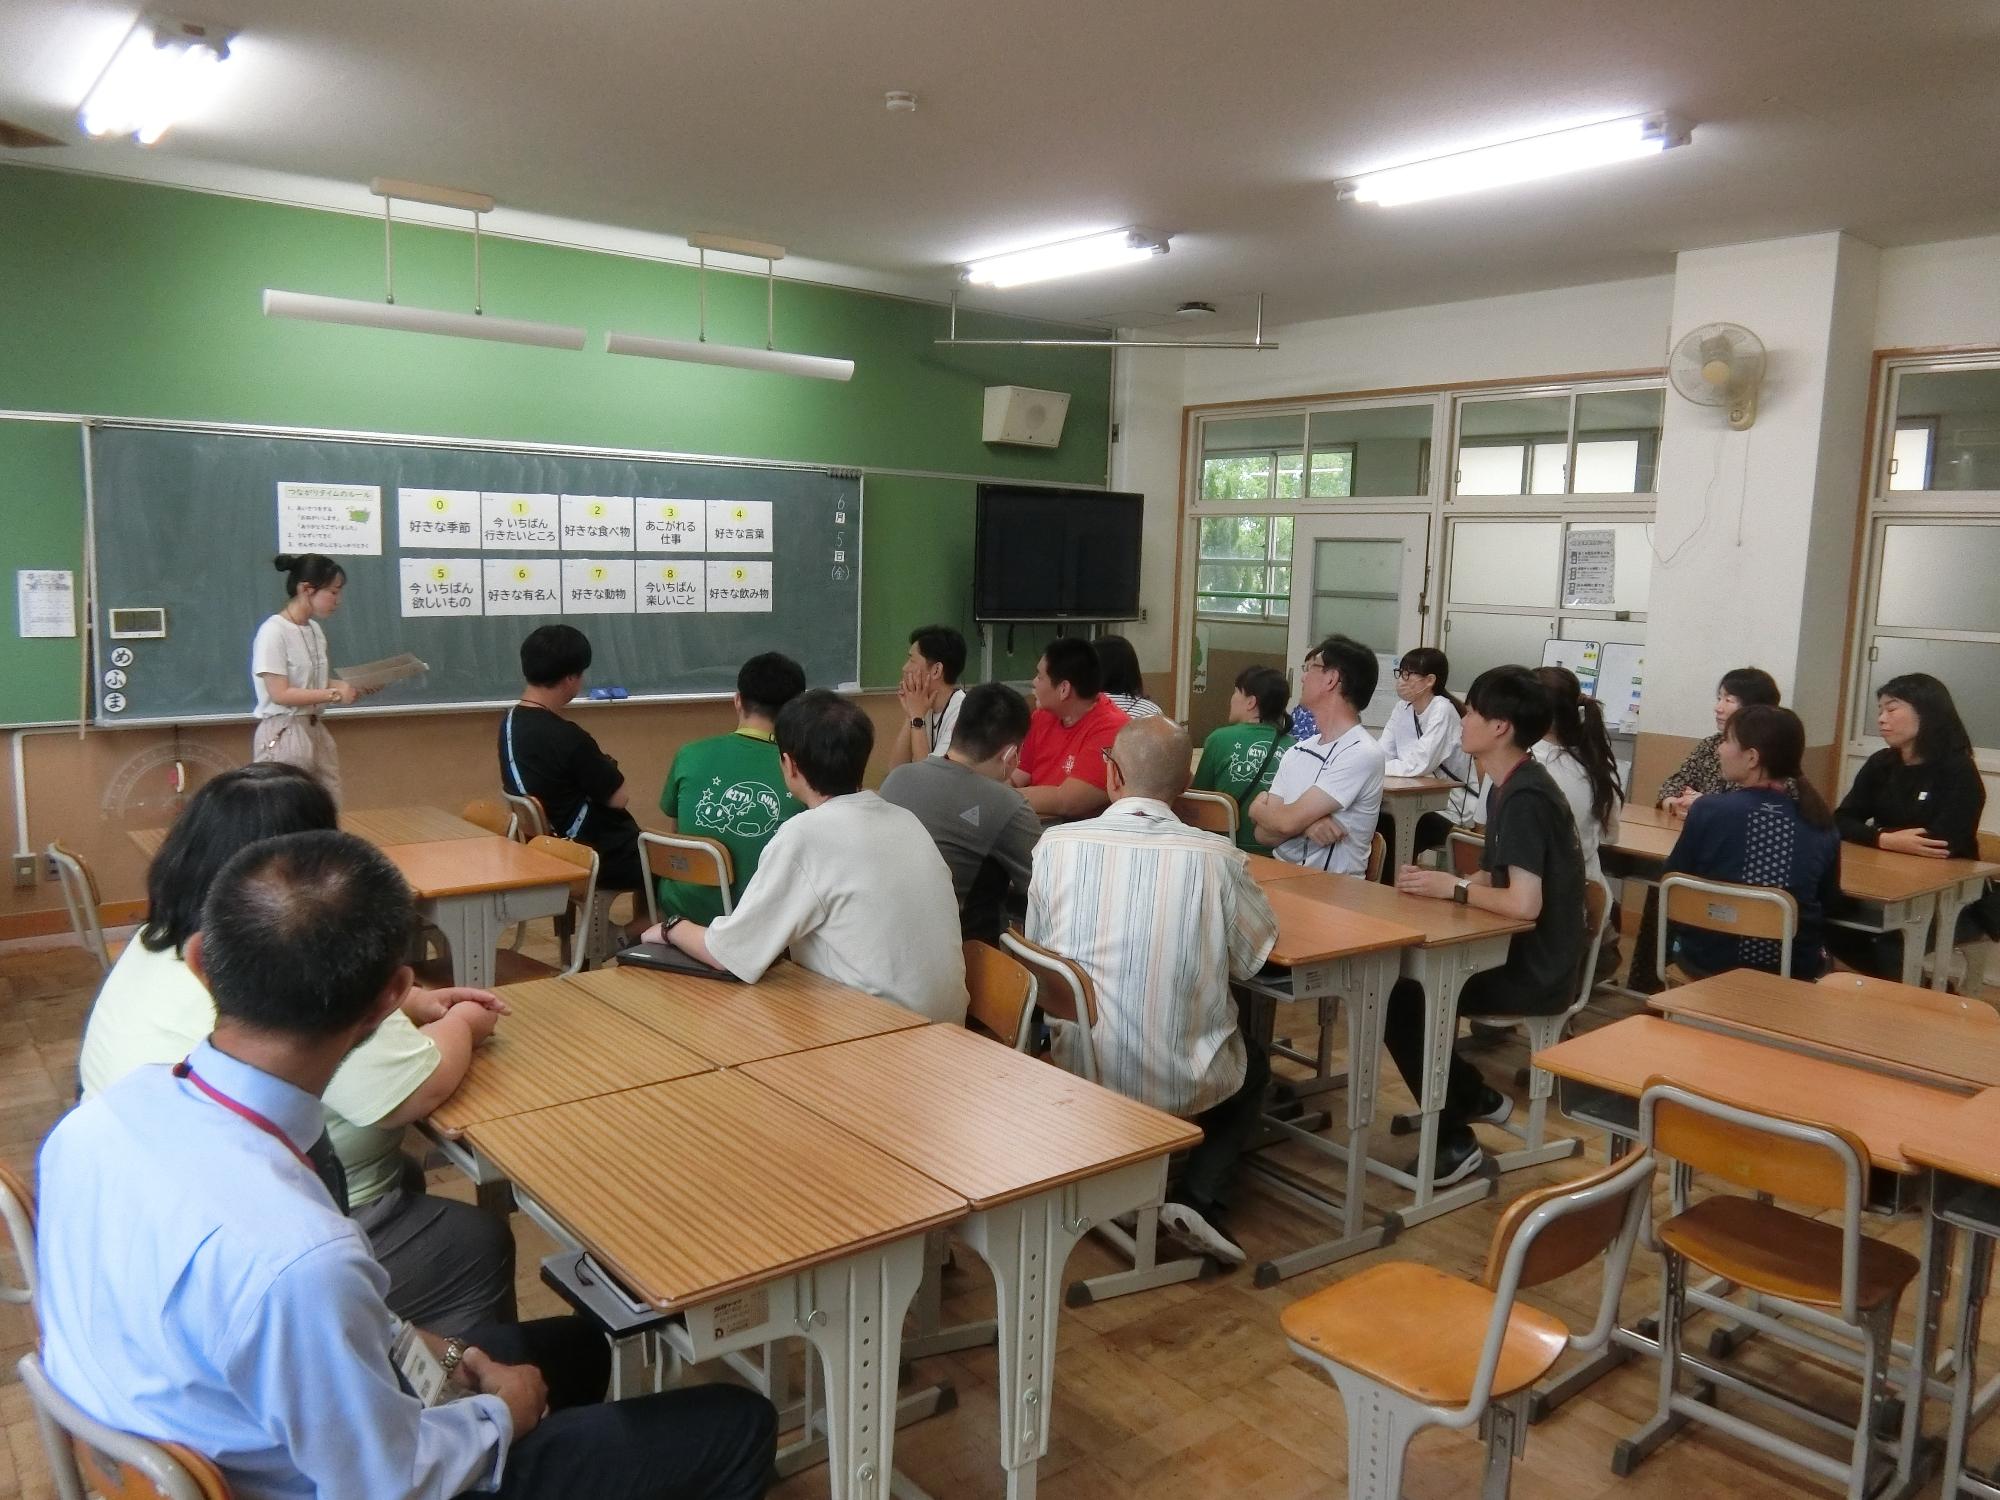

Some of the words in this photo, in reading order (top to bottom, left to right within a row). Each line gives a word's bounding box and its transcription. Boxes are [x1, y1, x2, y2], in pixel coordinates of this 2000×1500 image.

[436, 500, 444, 510] 0
[517, 503, 523, 512] 1
[594, 506, 601, 515] 2
[667, 509, 674, 517] 3
[736, 510, 743, 518] 4
[409, 520, 471, 534] 好きな季節
[564, 524, 631, 538] 好きな食べ物
[645, 520, 696, 532] あこがれる
[485, 530, 556, 542] 行きたいところ
[661, 533, 681, 545] 仕事
[715, 528, 765, 539] 好きな言葉
[437, 569, 445, 578] 5
[518, 569, 526, 578] 6
[595, 569, 602, 578] 7
[667, 569, 674, 578] 8
[736, 570, 743, 578] 9
[645, 582, 696, 593] 今いちばん
[487, 589, 557, 602] 好きな有名人
[571, 588, 627, 601] 好きな動物
[709, 588, 769, 599] 好きな飲み物
[412, 596, 472, 609] 欲しいもの
[646, 595, 696, 606] 楽しいこと
[114, 650, 131, 664] め
[107, 671, 123, 686] ふ
[109, 694, 122, 709] ま
[725, 788, 750, 802] KITA
